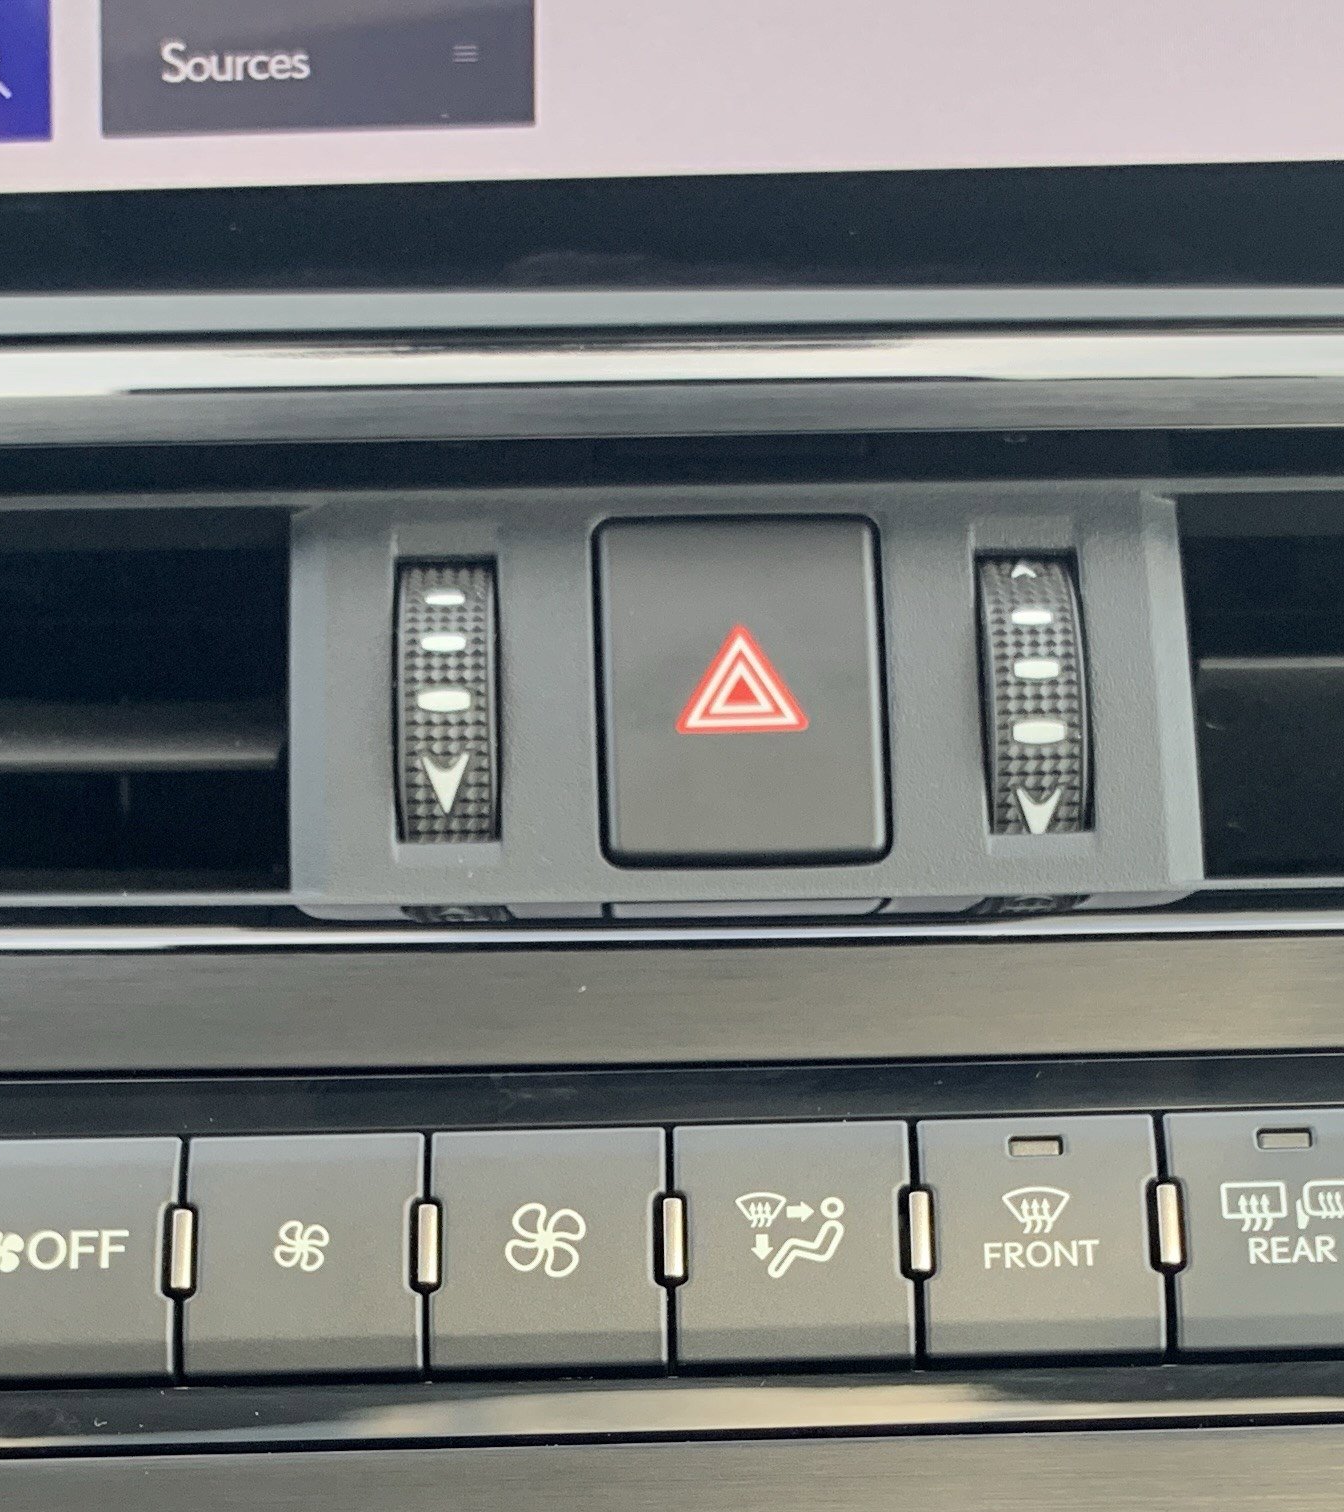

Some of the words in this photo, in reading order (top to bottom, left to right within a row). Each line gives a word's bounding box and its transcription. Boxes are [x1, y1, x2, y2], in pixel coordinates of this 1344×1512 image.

[161, 40, 311, 84] Sources
[27, 1229, 130, 1271] OFF
[983, 1238, 1100, 1270] FRONT
[1248, 1236, 1339, 1265] REAR
